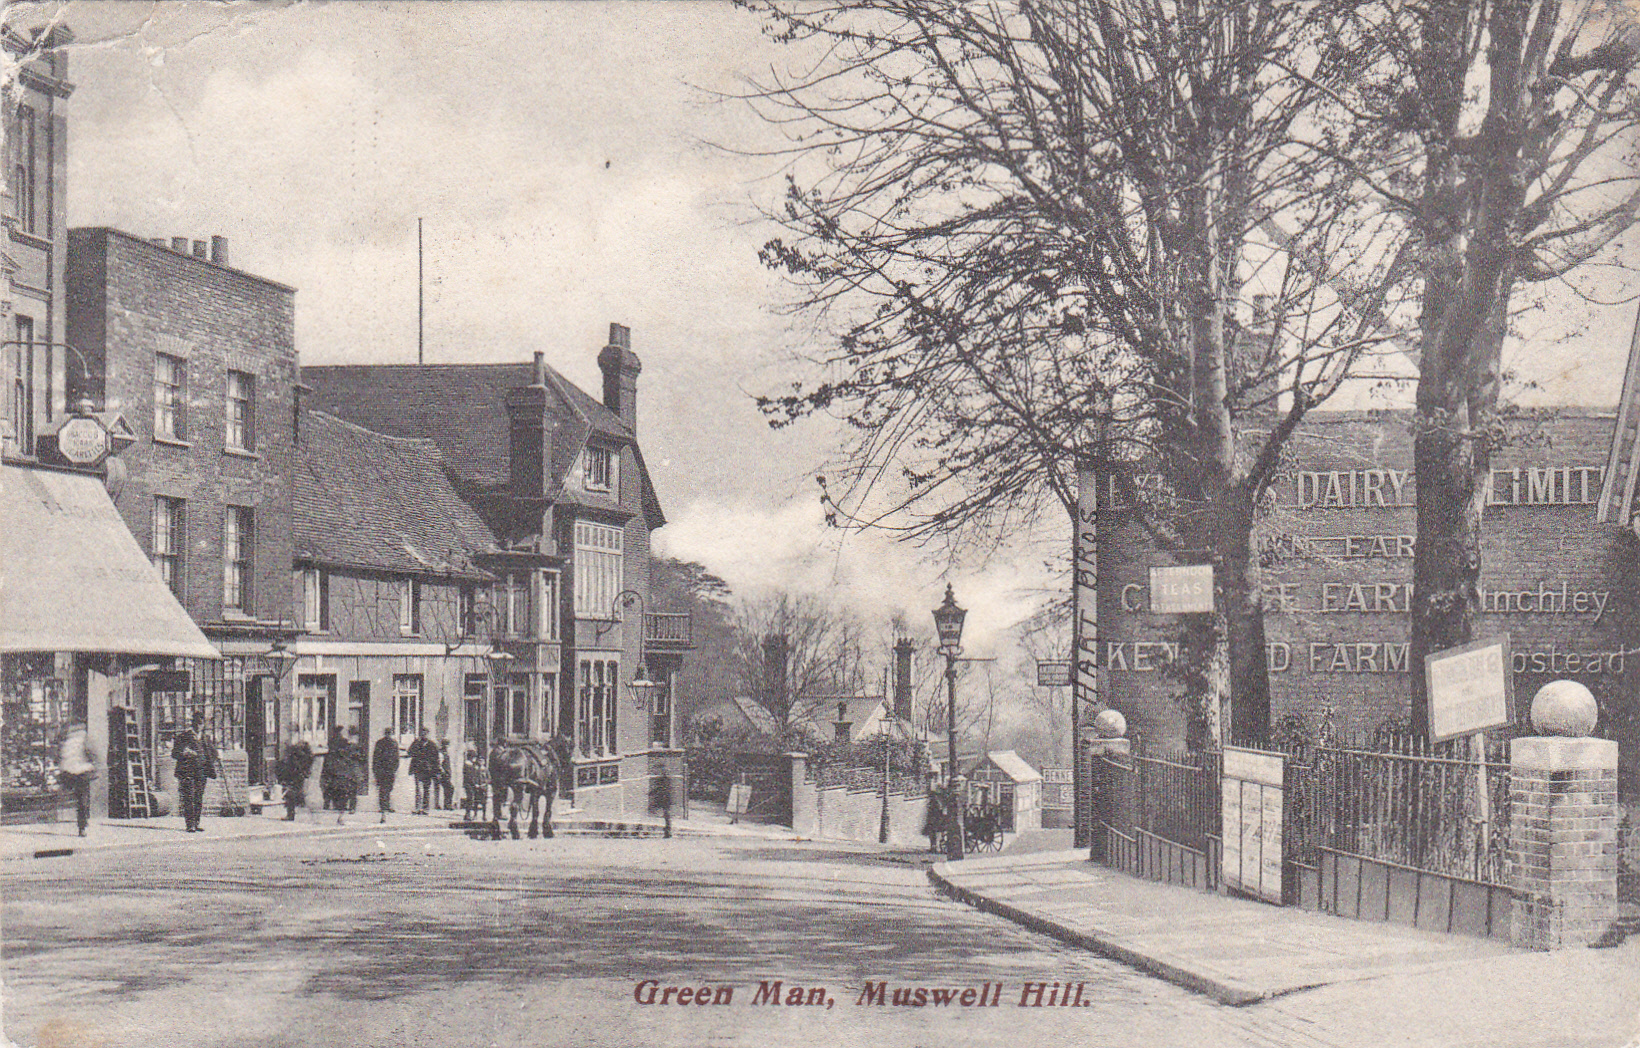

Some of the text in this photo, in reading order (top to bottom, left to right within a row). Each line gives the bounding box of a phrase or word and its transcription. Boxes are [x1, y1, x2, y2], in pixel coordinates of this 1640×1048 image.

[1298, 466, 1606, 508] DAIRY LIMIT
[1346, 534, 1418, 558] FAR
[1075, 508, 1100, 705] HART BROS
[1161, 582, 1203, 596] TEAS
[1481, 581, 1610, 622] inchley
[1309, 642, 1412, 673] FARM
[1510, 644, 1625, 677] pstead
[1045, 771, 1072, 782] BENNE
